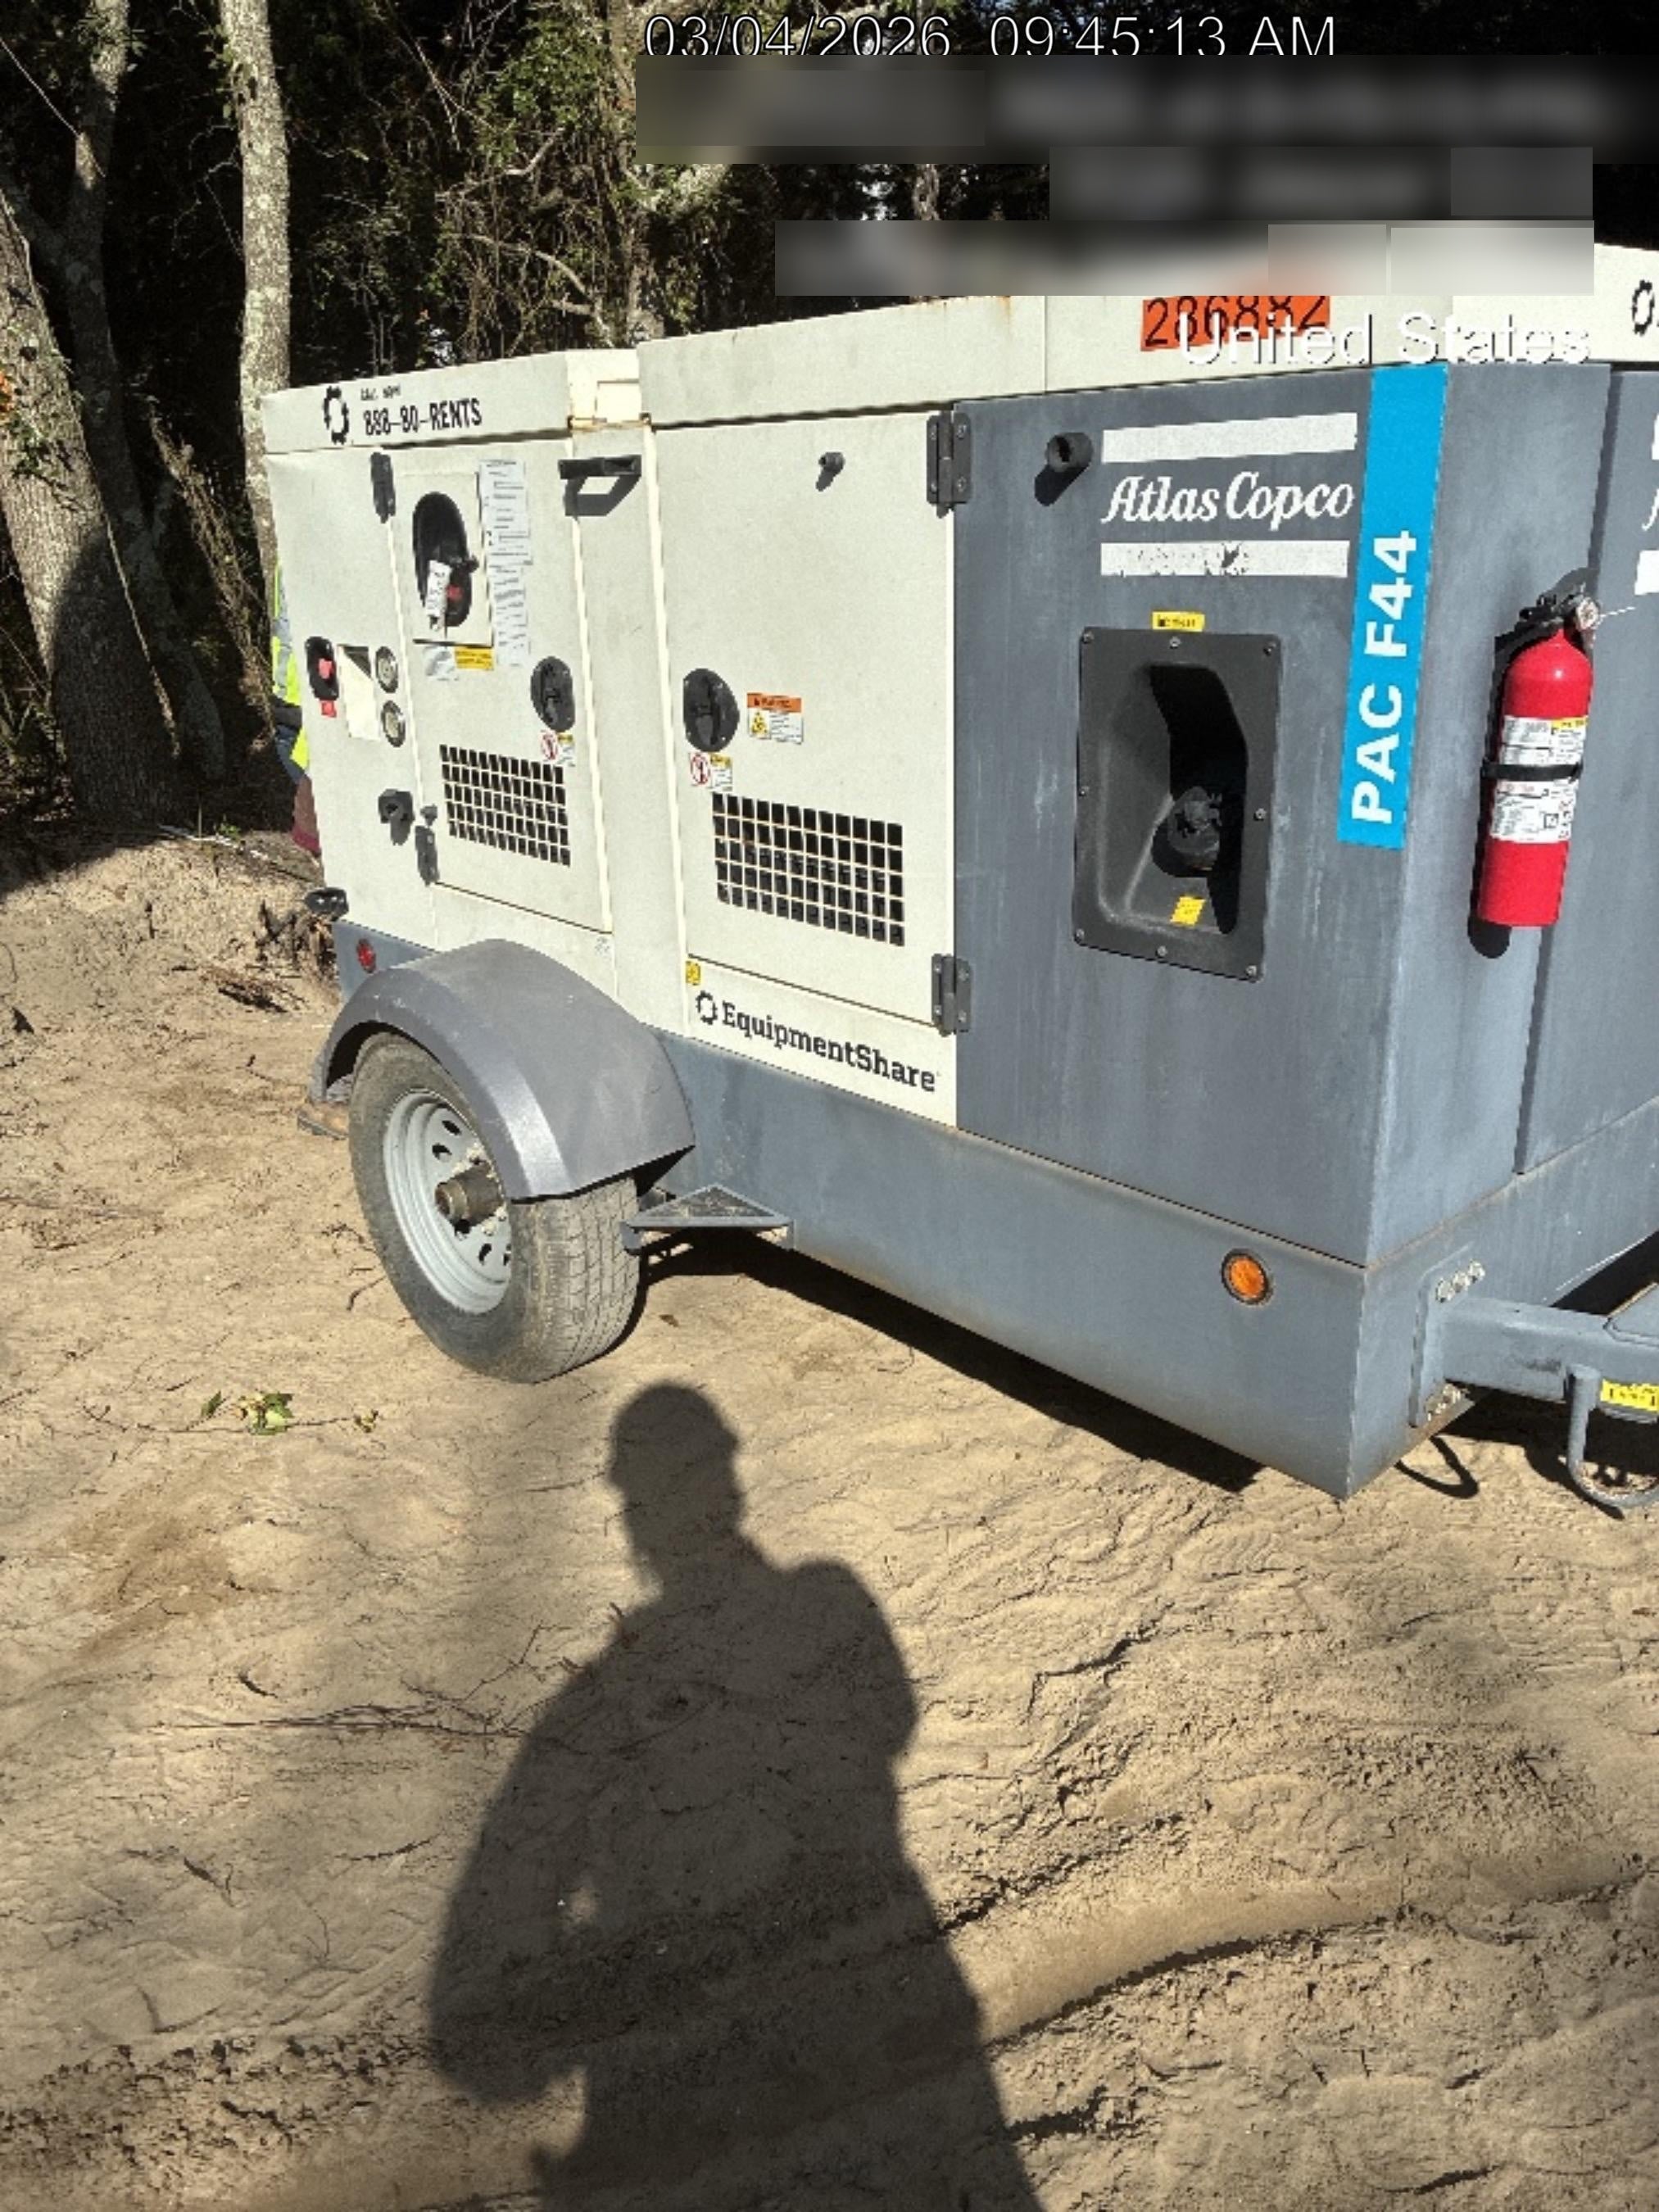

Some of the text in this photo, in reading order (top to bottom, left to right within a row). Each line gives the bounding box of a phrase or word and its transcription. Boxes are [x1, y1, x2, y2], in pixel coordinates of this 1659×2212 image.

[1100, 471, 1355, 531] Atlas Copco
[1351, 530, 1417, 825] PAC F44
[722, 999, 936, 1092] EquipmentShare
